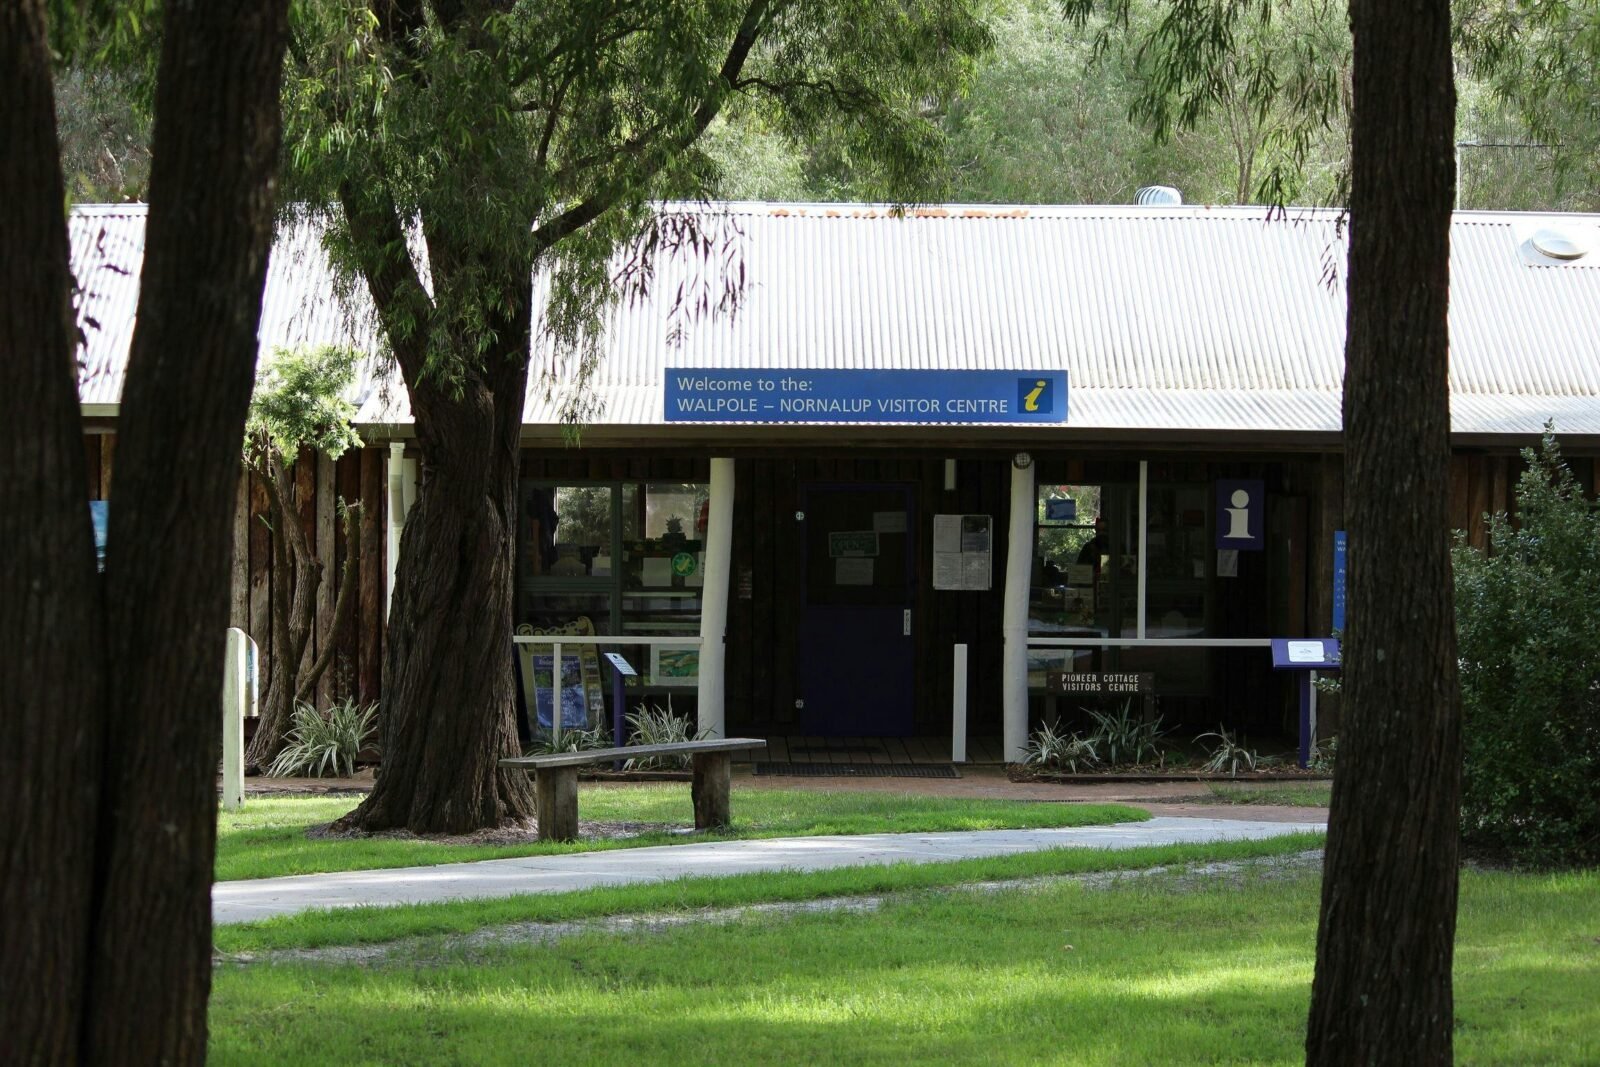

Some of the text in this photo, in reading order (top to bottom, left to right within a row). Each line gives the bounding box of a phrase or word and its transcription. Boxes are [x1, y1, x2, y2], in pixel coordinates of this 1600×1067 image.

[677, 376, 813, 391] Welcome to the:
[677, 398, 757, 412] WALPOLE
[780, 398, 872, 413] NORNALUP
[878, 399, 940, 413] VISITOR
[946, 399, 1008, 413] CENTRE
[1061, 673, 1139, 683] PIONEER COTTAGE
[1062, 682, 1139, 692] VISITORS CENTRE
